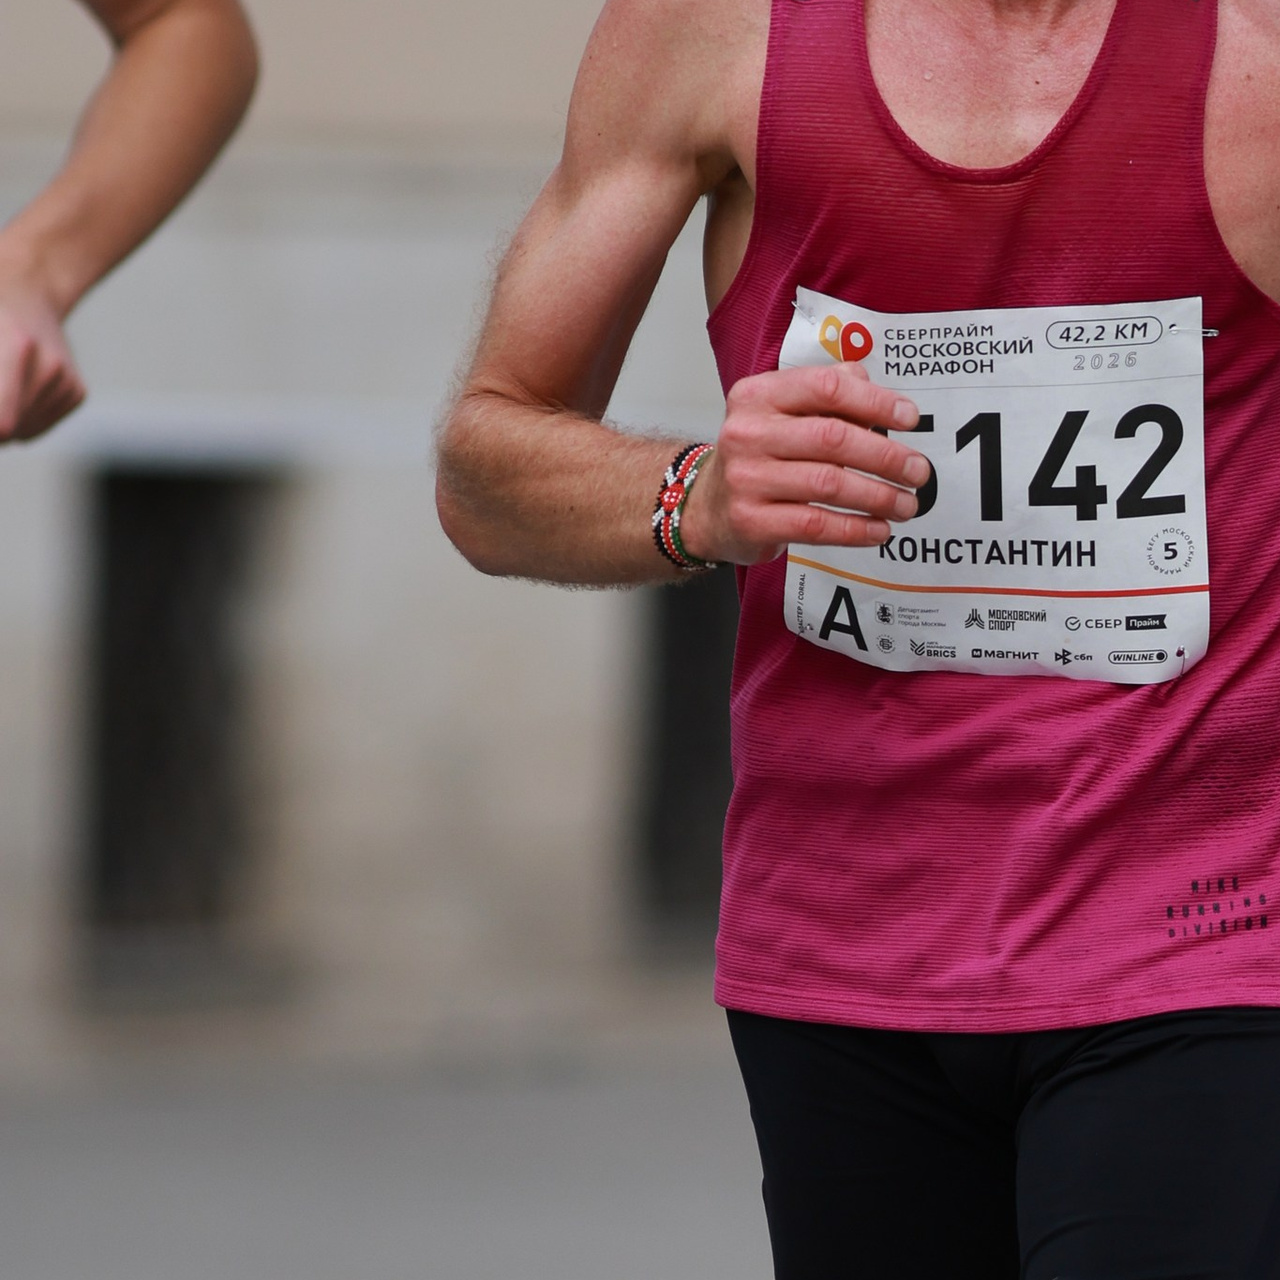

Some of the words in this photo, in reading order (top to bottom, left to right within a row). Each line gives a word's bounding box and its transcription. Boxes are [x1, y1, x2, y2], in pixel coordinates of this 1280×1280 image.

[884, 324, 994, 341] СБЕРПРАЙМ
[1059, 326, 1106, 344] 42,2
[1114, 322, 1149, 340] КМ
[884, 337, 1034, 359] МОСКОВСКИЙ
[884, 359, 995, 376] МАРАФОН
[1073, 351, 1138, 371] 2026
[879, 535, 1097, 568] КОНСТАНТИН
[1164, 542, 1179, 560] 5
[798, 573, 806, 600] CORRAL
[819, 585, 869, 652] A
[988, 609, 1047, 622] МОСКОВСКИЙ
[1085, 618, 1122, 629] СБЕР
[1129, 617, 1160, 629] Прайм
[988, 621, 1015, 631] СПОРТ
[926, 650, 956, 658] BRICS
[1112, 653, 1155, 662] WINLINE
